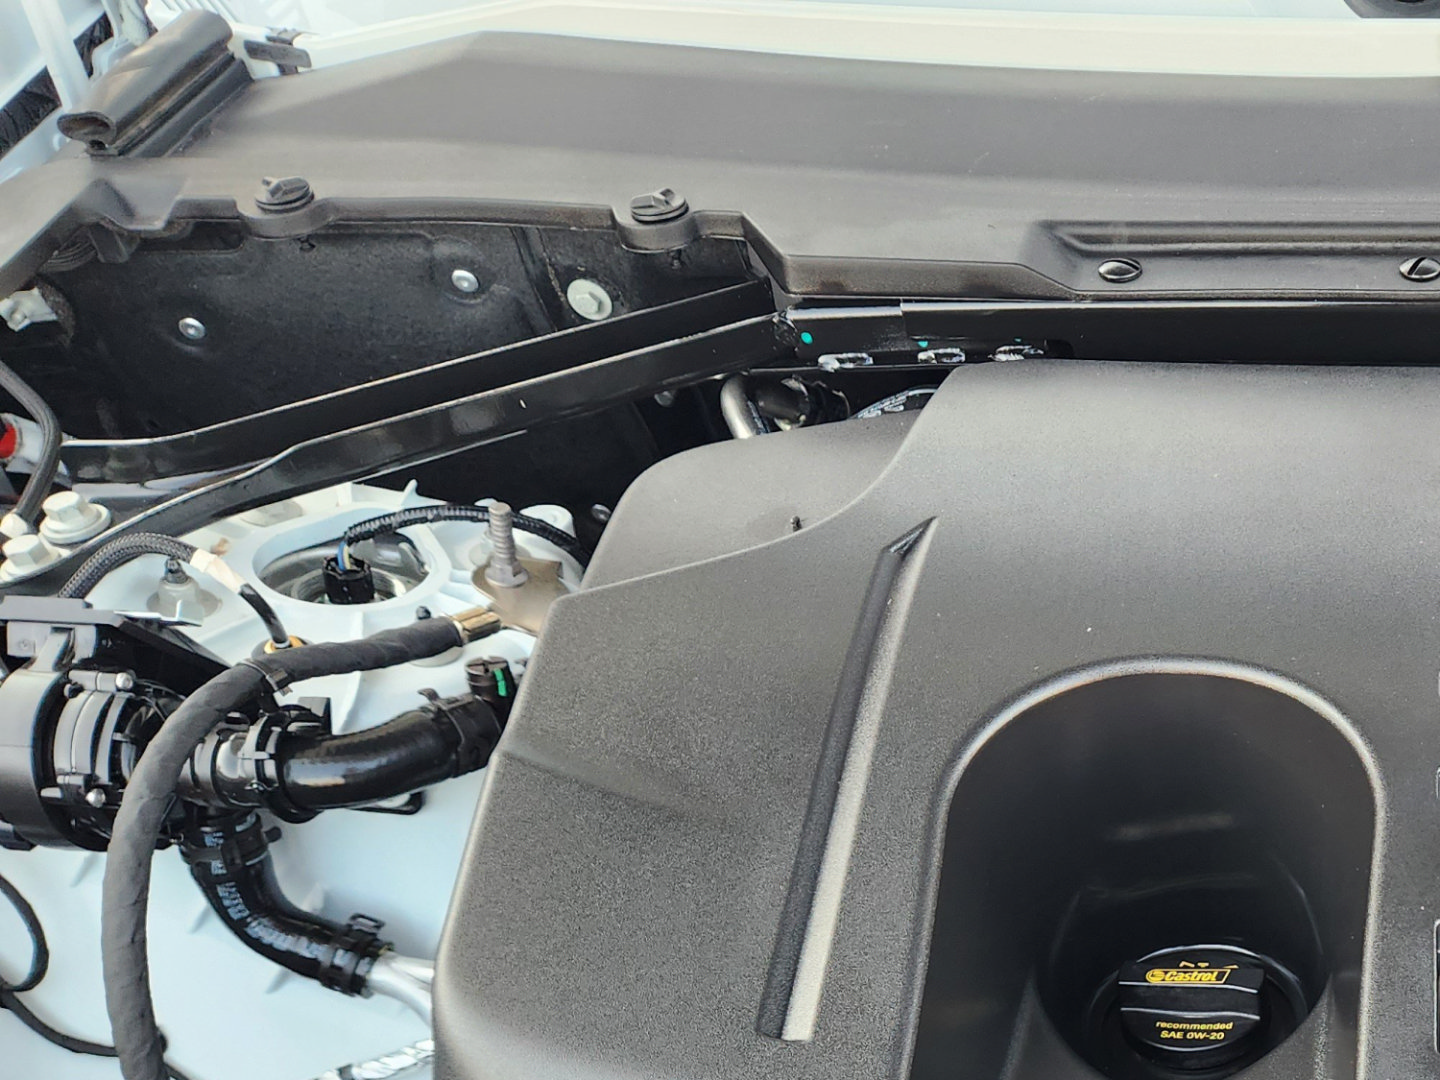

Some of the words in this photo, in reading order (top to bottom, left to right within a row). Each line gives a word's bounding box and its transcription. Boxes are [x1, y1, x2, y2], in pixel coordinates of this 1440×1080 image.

[1164, 971, 1219, 982] Castrol
[1156, 1021, 1234, 1030] recommended
[1160, 1030, 1184, 1040] SAE
[1186, 1031, 1225, 1040] 0W-20
